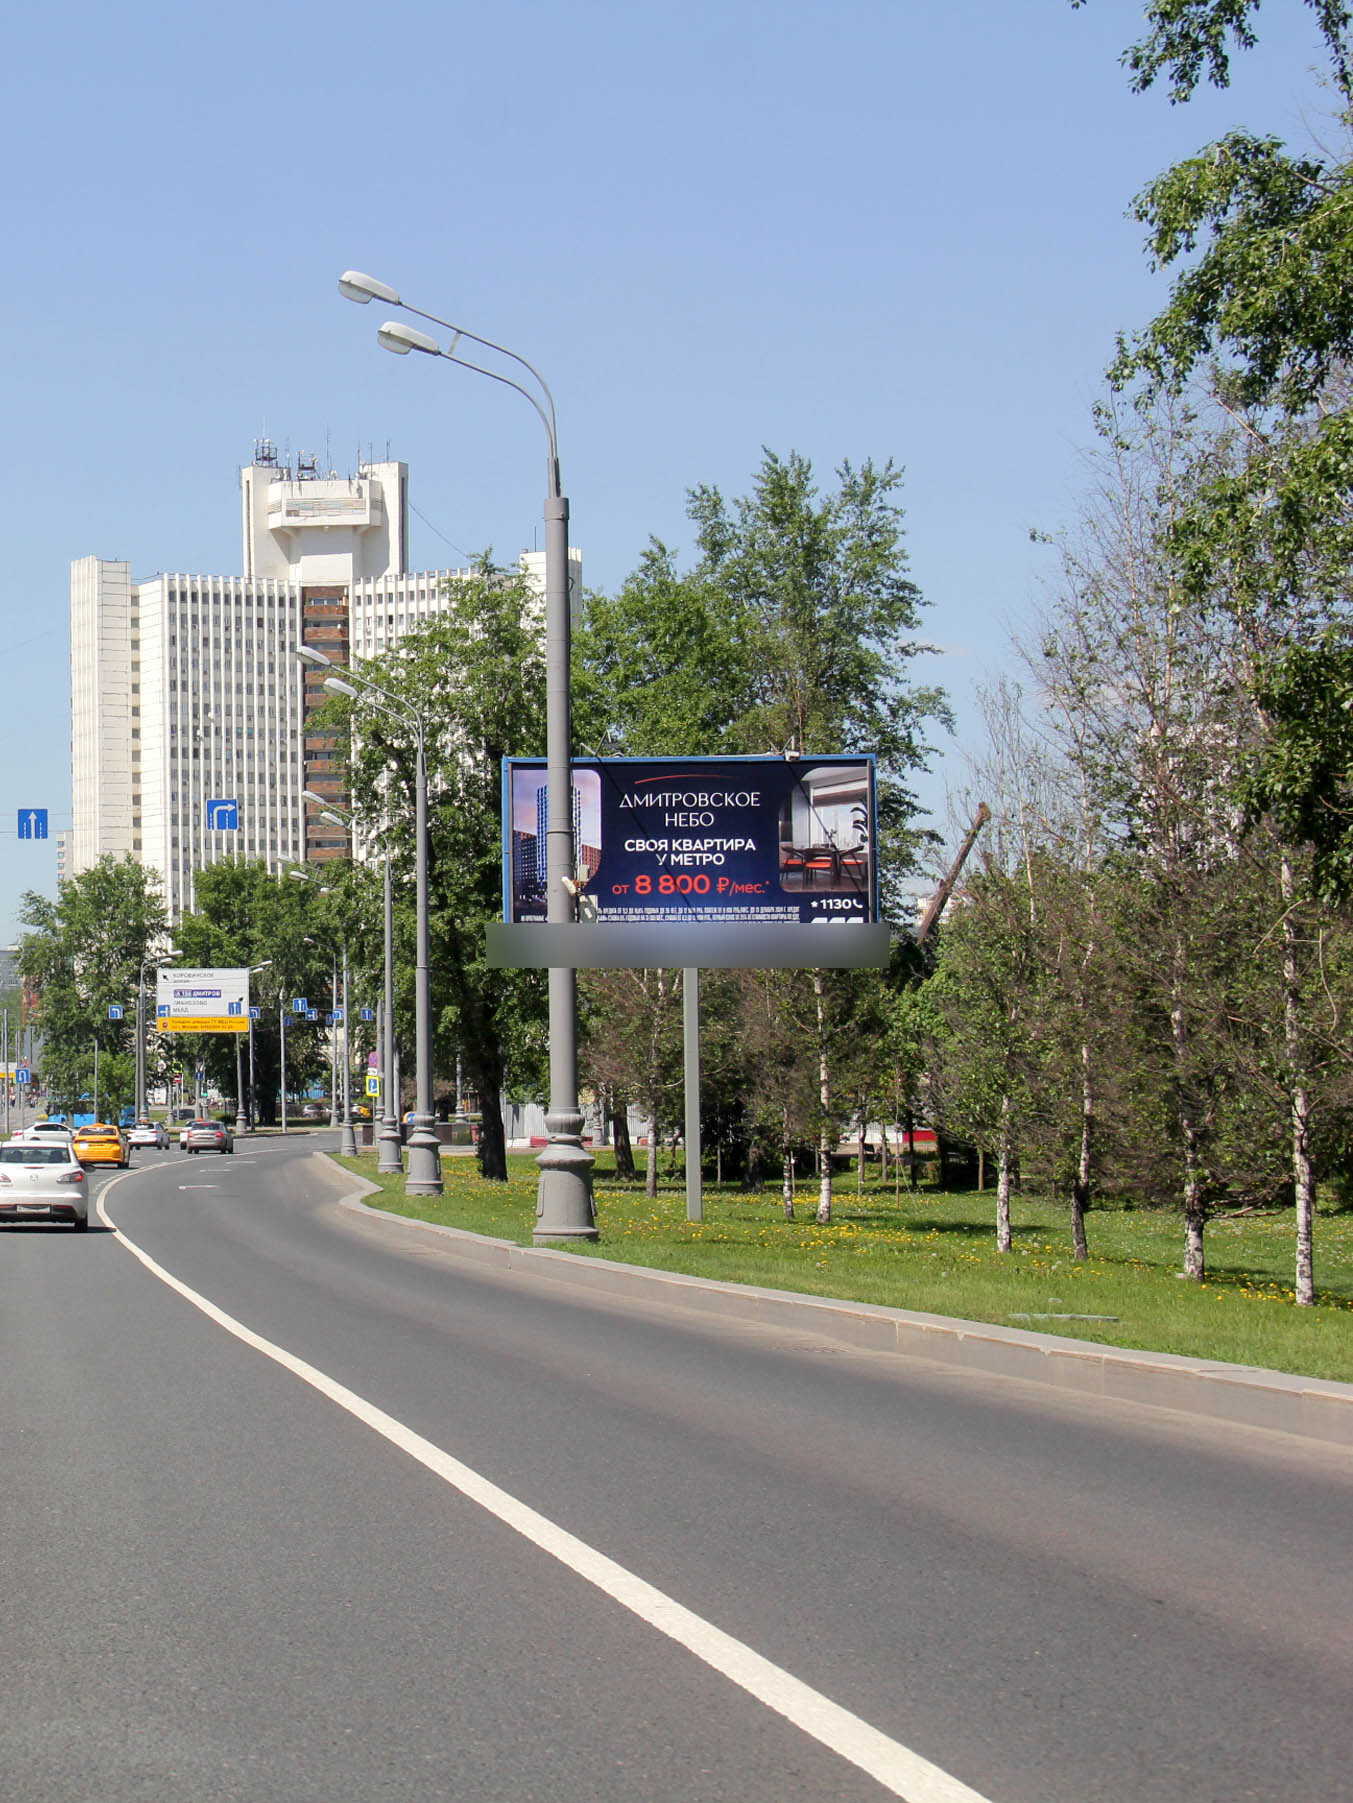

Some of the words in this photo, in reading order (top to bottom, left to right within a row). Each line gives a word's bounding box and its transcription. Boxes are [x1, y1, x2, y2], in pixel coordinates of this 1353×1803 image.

[619, 792, 761, 808] ДМИТРОВСКОЕ
[664, 811, 715, 828] НЕБО
[624, 839, 668, 852] СВОЯ
[671, 838, 757, 851] КВАРТИРА
[655, 853, 667, 866] У
[670, 852, 726, 866] МЕТРО
